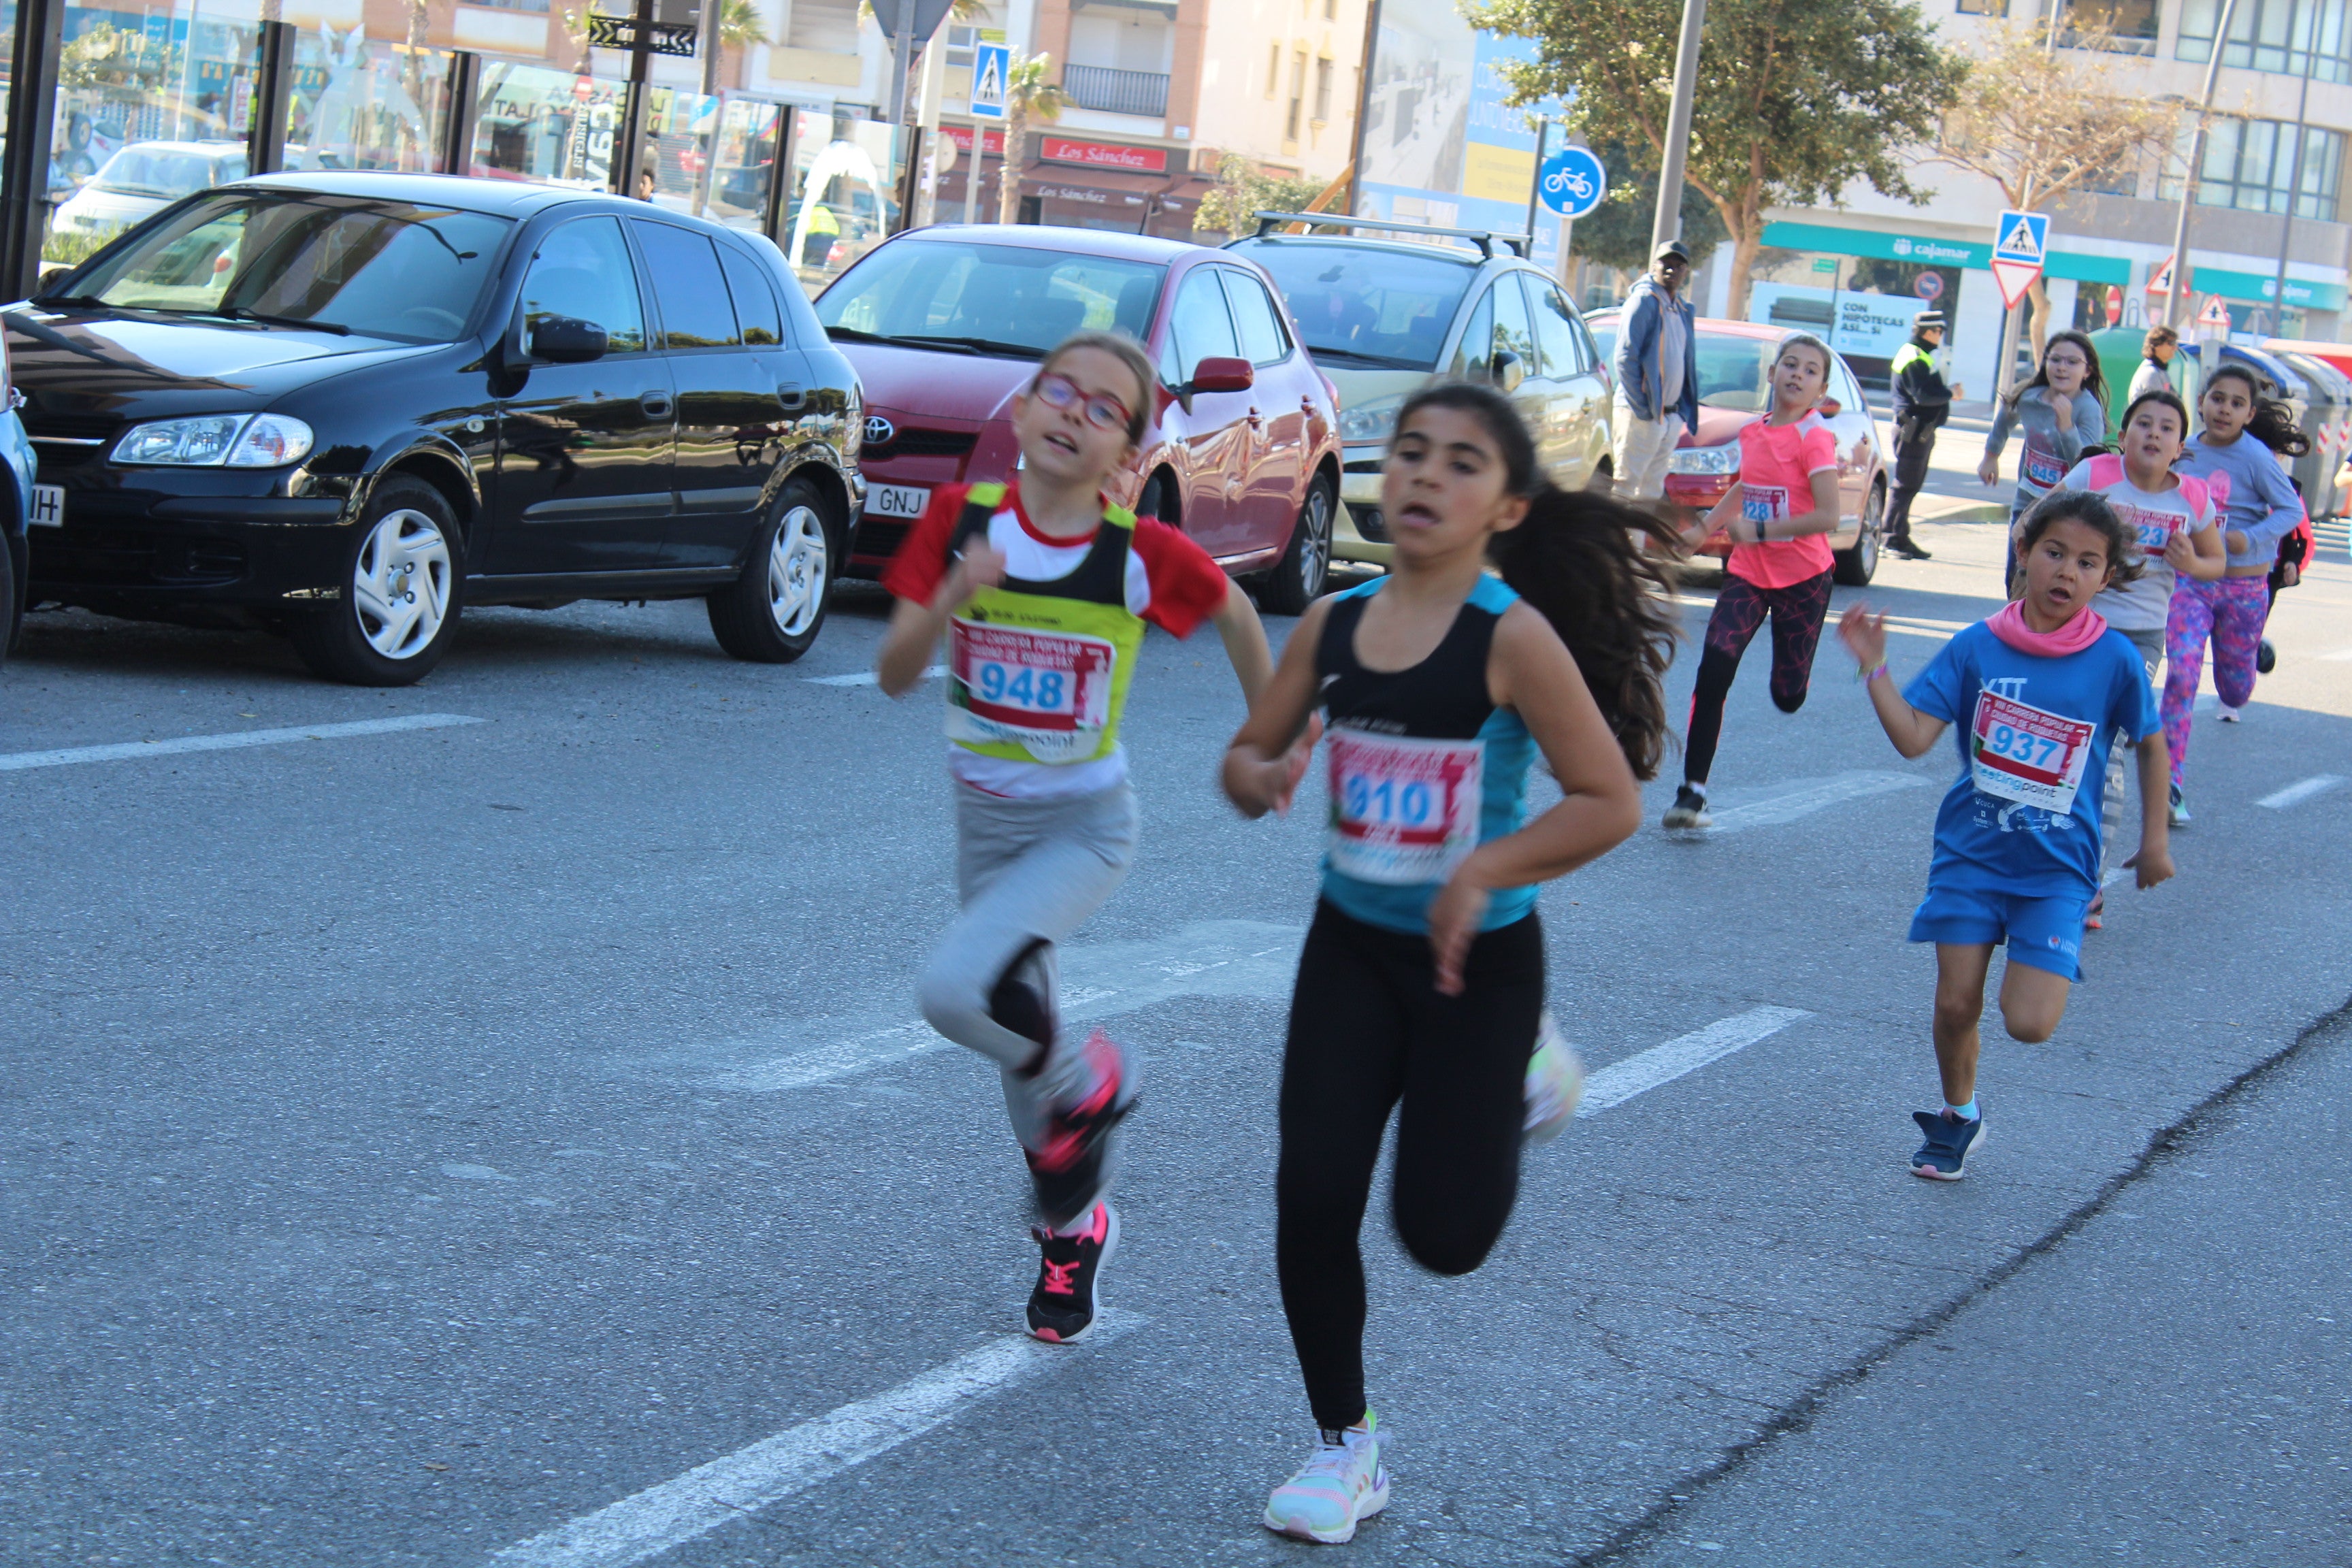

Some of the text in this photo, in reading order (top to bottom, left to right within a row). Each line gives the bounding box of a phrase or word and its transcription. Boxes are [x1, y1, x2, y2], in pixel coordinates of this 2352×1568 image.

[1056, 144, 1145, 166] Los Sánchez
[1036, 185, 1107, 203] Los Sánchez
[1914, 243, 1971, 259] cajamar
[2283, 283, 2312, 299] ajamar
[1843, 302, 1868, 312] CON
[1842, 313, 1904, 327] HIPOTECAS
[2031, 463, 2057, 483] 945
[880, 488, 921, 514] GNJ
[2137, 524, 2164, 546] 23
[980, 663, 1064, 709] 948
[1991, 709, 2018, 725] CIUDAD
[2016, 719, 2029, 730] DE
[2006, 704, 2040, 722] CARRERA
[2040, 715, 2076, 733] POPULAR
[1992, 724, 2059, 768] 937
[1345, 772, 1431, 830] 910
